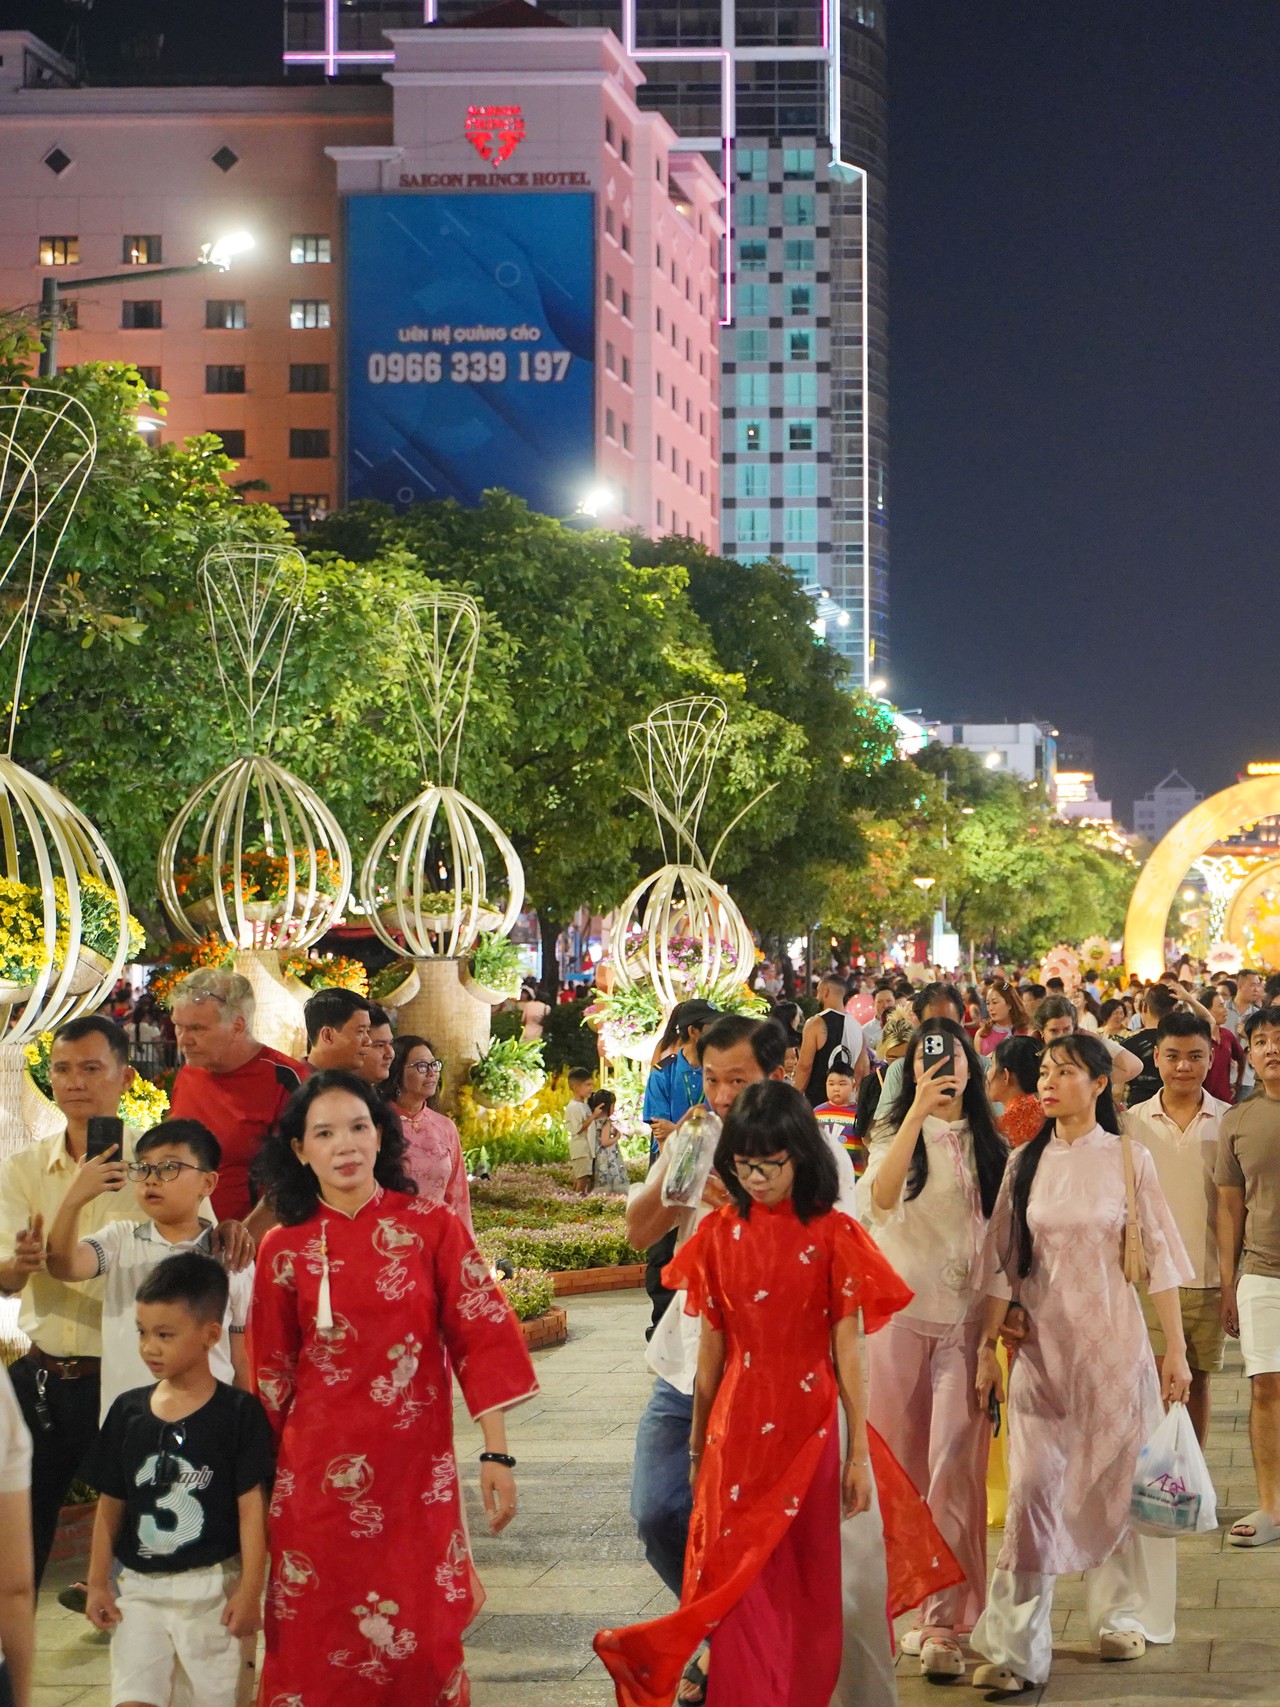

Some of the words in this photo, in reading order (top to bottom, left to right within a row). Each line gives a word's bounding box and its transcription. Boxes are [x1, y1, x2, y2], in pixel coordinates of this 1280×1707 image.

[400, 174, 463, 187] SAIGON
[467, 173, 529, 187] PRINCE
[533, 172, 591, 186] HOTEL
[399, 325, 429, 342] LIÊN
[432, 325, 450, 345] HỆ
[510, 324, 541, 341] CÁO
[369, 352, 442, 383] 0966
[451, 352, 506, 382] 339
[518, 351, 571, 381] 197
[135, 1454, 205, 1559] 3
